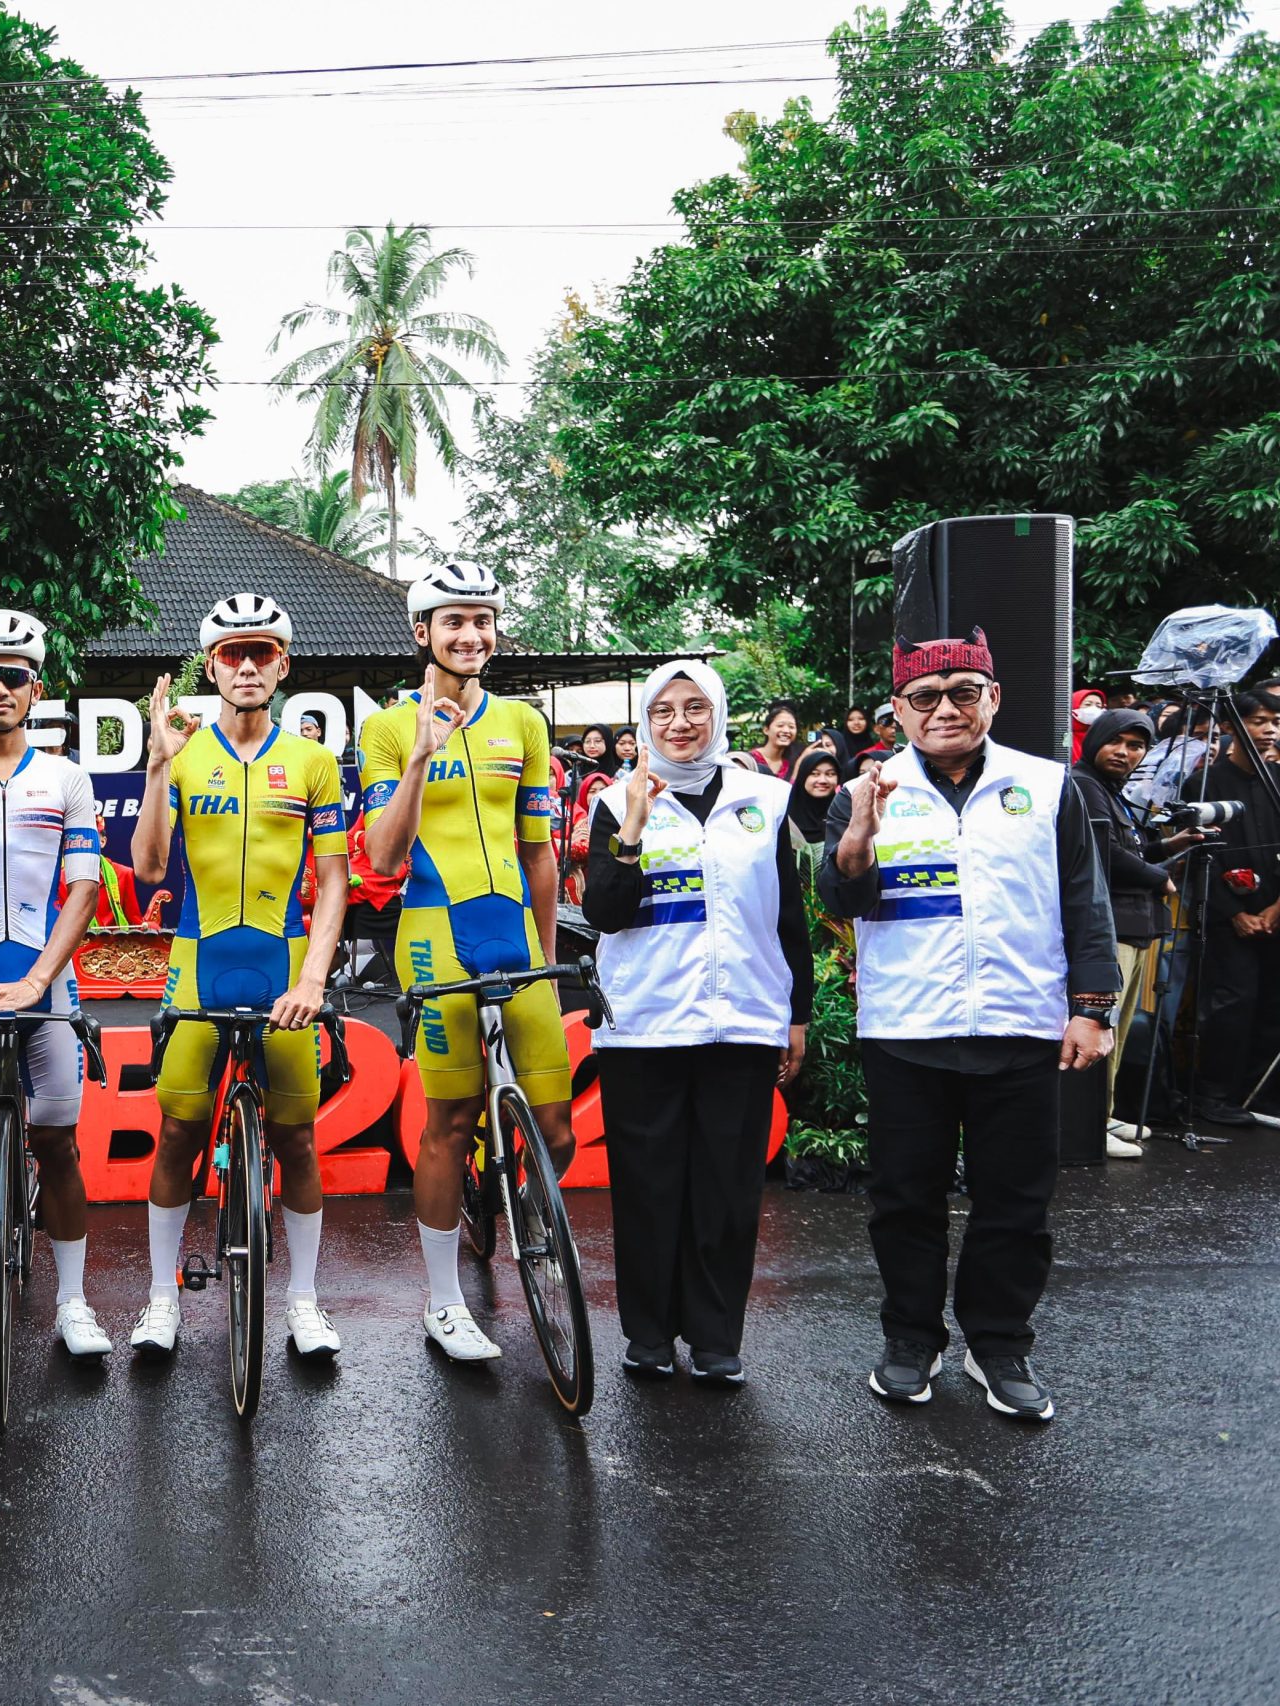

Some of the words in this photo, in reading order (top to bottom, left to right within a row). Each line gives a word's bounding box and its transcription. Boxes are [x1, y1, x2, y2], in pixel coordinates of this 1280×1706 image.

[427, 760, 467, 782] HA
[188, 794, 240, 816] THA
[409, 939, 450, 1055] THAAND
